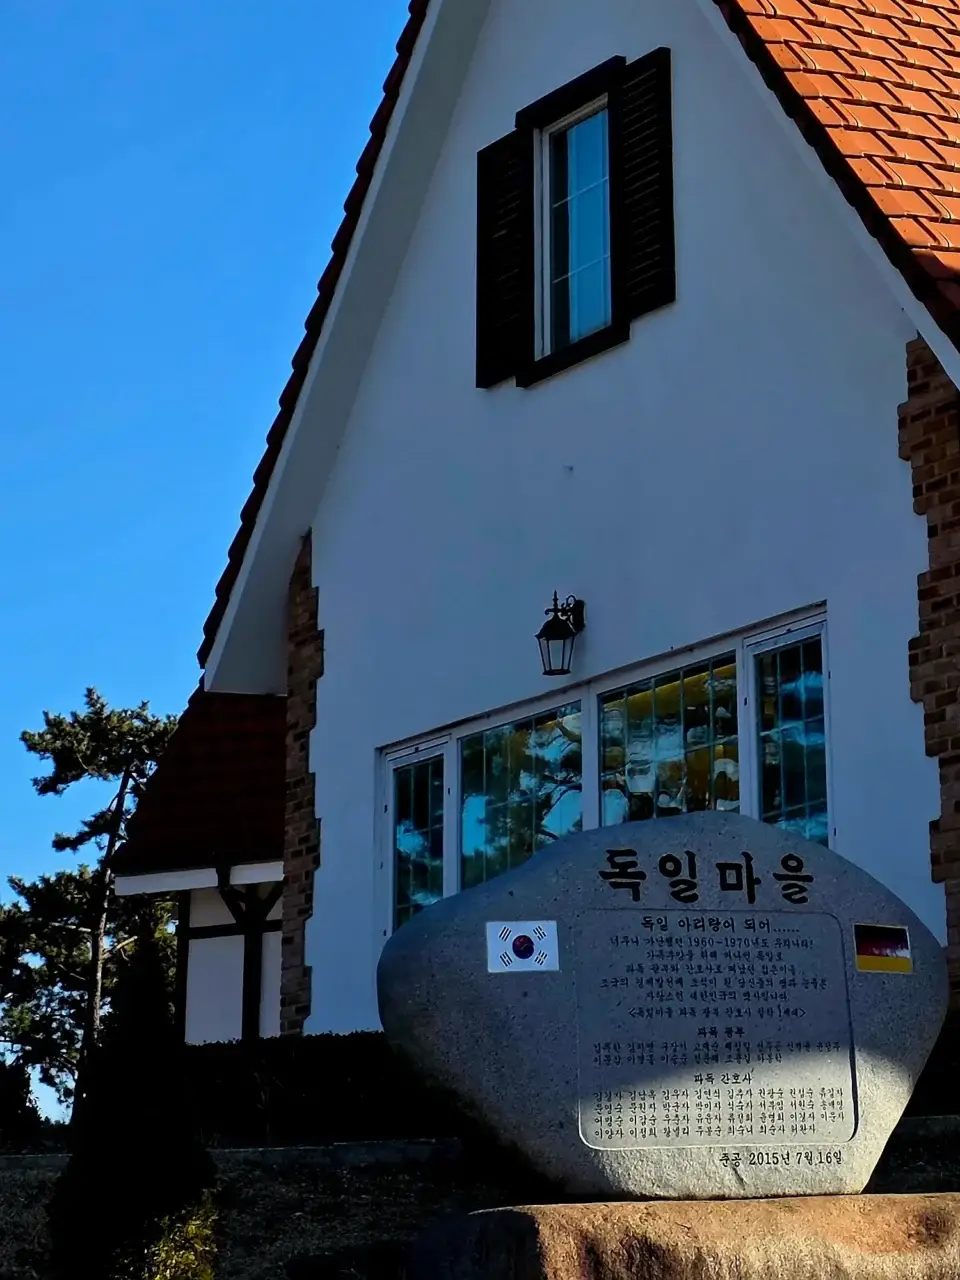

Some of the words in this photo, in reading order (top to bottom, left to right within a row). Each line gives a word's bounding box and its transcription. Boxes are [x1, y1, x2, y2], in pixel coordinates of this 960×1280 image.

[598, 848, 814, 904] 독일마을
[641, 915, 668, 932] 독일
[677, 916, 735, 933] 아리랑이
[693, 1072, 717, 1086] 파독
[721, 1072, 753, 1086] 간호사
[719, 1152, 742, 1168] 준공
[748, 1150, 790, 1166] 2015년
[796, 1150, 813, 1166] 7월
[818, 1149, 842, 1165] 16일
